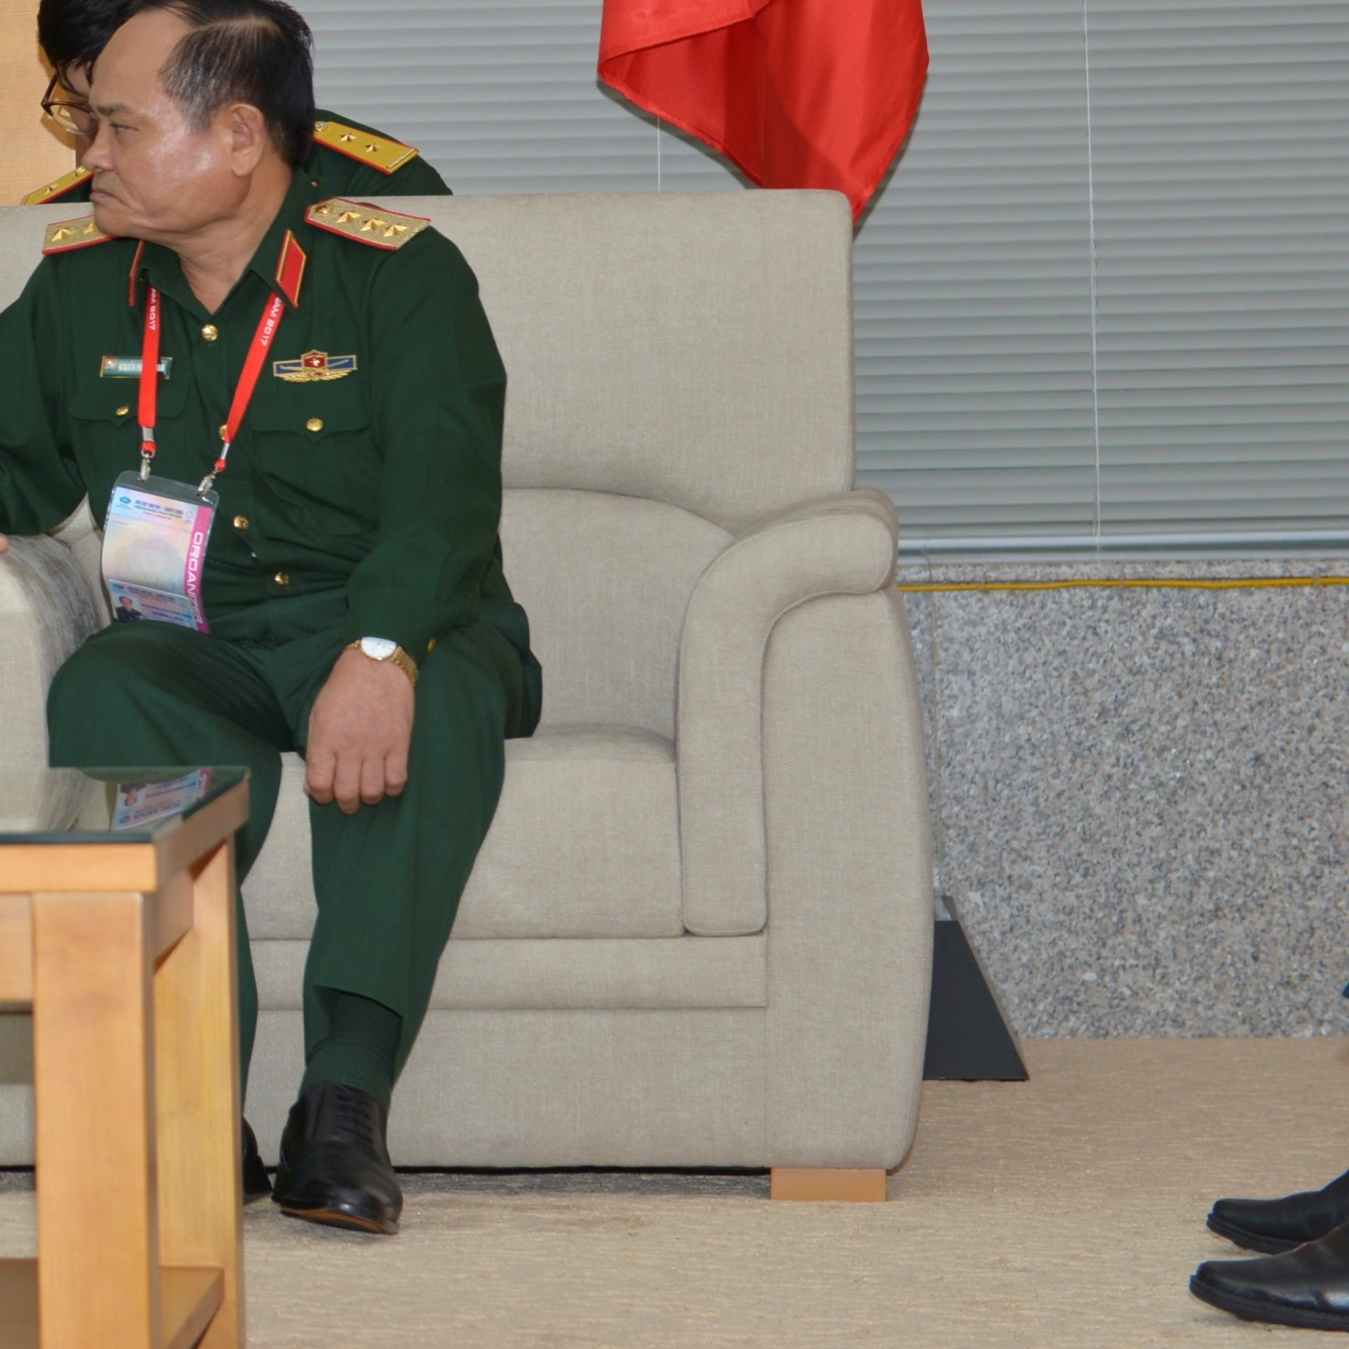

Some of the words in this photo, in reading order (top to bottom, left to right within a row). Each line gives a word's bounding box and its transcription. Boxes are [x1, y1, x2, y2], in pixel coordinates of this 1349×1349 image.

[149, 305, 157, 331] 2017
[260, 318, 275, 346] 2017
[186, 531, 204, 624] ORGANIZER
